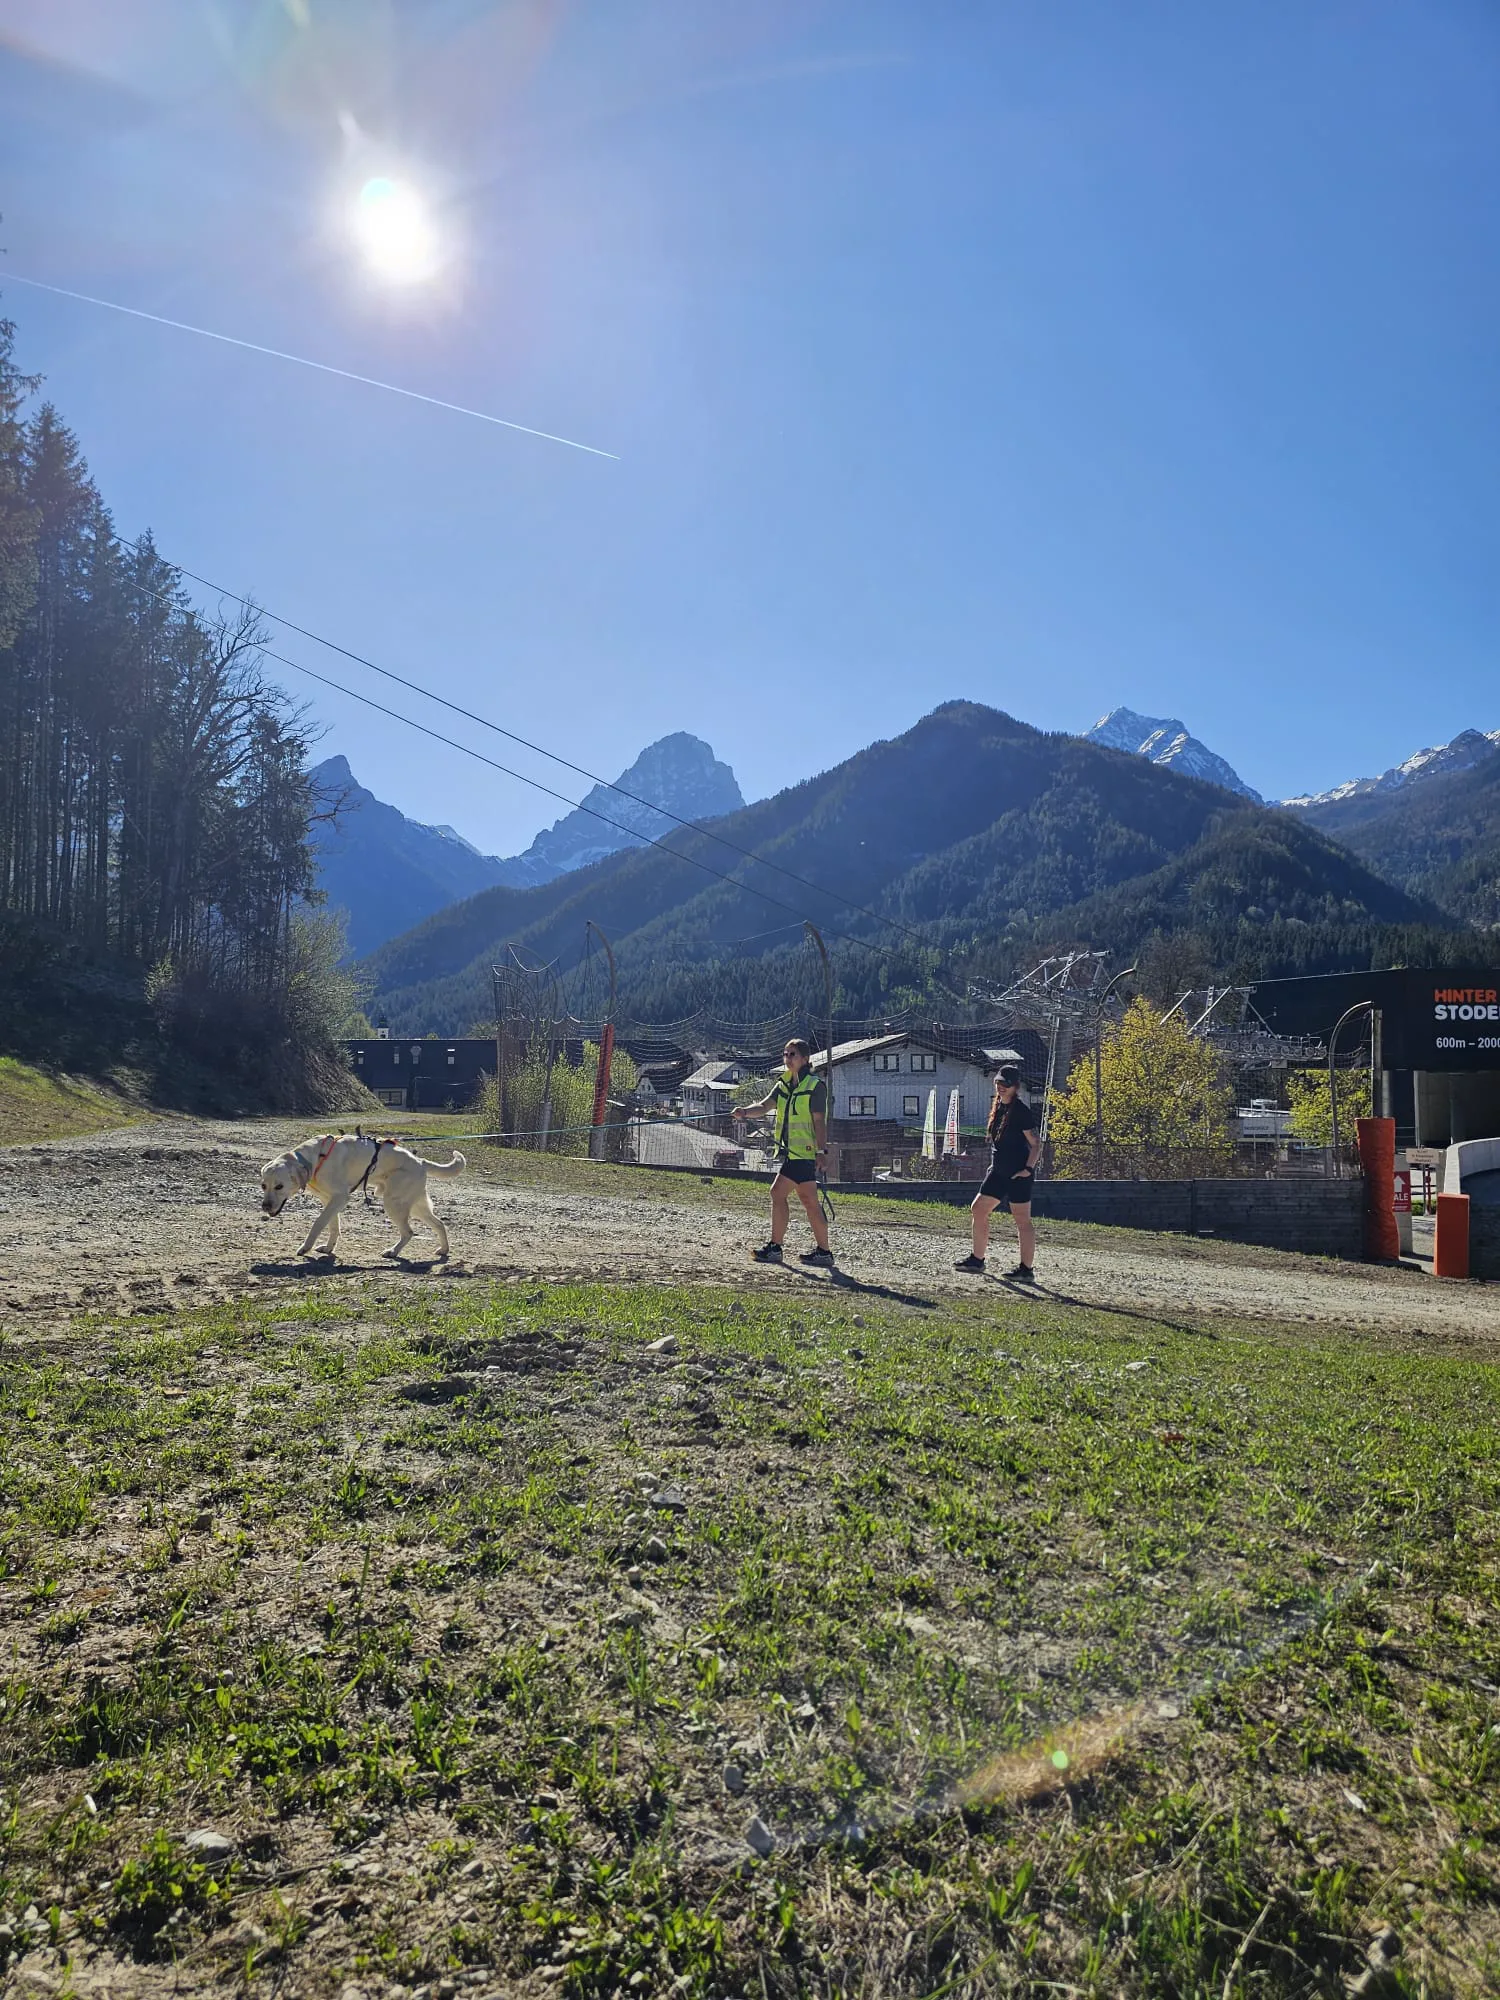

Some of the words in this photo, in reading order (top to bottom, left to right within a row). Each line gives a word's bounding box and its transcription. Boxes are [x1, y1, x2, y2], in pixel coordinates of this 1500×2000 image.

[1434, 989, 1497, 1003] HINTER
[1434, 1004, 1500, 1020] STODE
[1436, 1037, 1466, 1048] 600m
[1393, 1193, 1409, 1201] ALE
